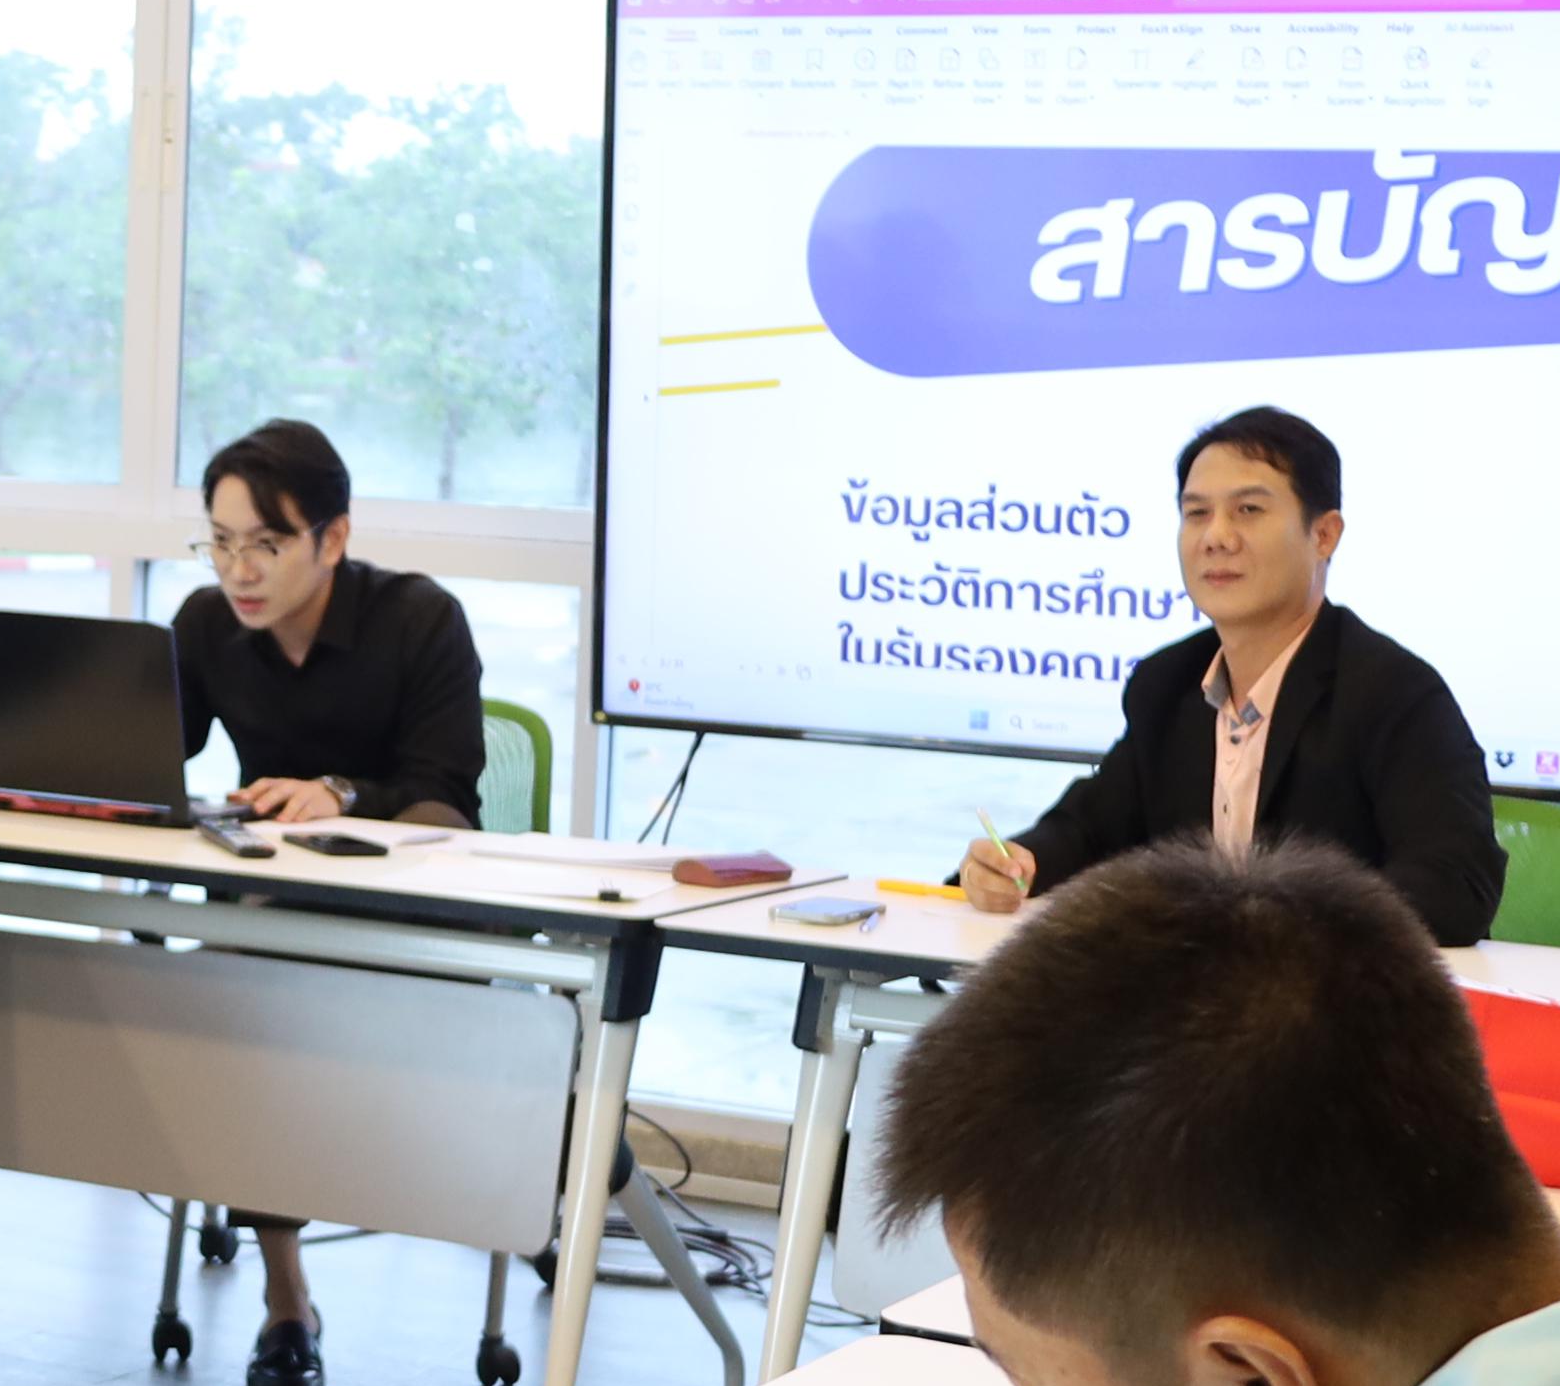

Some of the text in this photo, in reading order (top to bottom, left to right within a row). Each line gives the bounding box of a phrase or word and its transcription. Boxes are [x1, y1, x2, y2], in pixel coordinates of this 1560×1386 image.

[972, 25, 998, 35] View
[1076, 24, 1116, 35] Protect
[1230, 23, 1261, 34] Share
[1288, 22, 1360, 36] Accessibility
[1386, 22, 1414, 36] Help
[840, 478, 1131, 542] ข้อมูลส่วนตัว
[839, 560, 1202, 623] ประวัติการศึกษา
